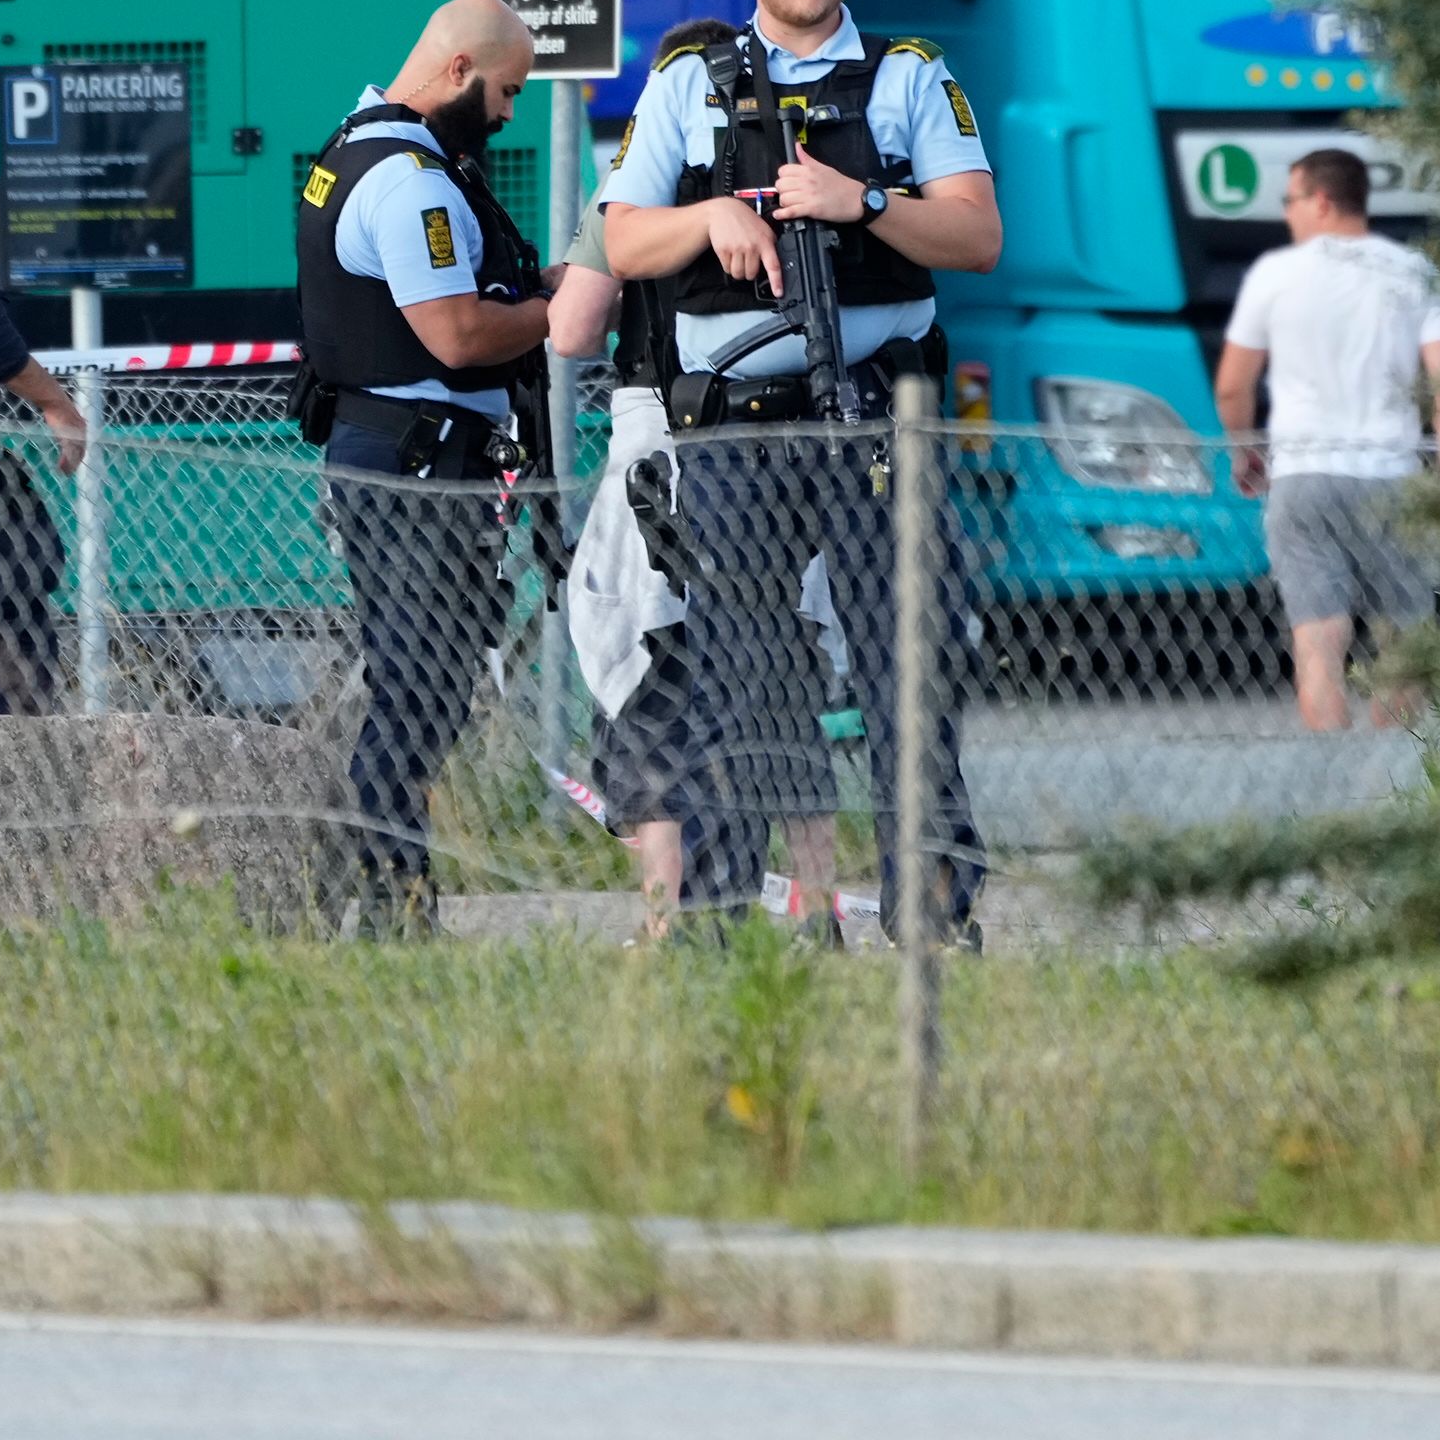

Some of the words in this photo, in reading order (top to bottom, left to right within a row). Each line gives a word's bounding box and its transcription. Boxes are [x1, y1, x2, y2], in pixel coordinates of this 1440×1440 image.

[564, 4, 598, 25] skilte
[12, 81, 49, 140] P
[62, 74, 184, 99] PARKERING
[1210, 150, 1247, 204] L
